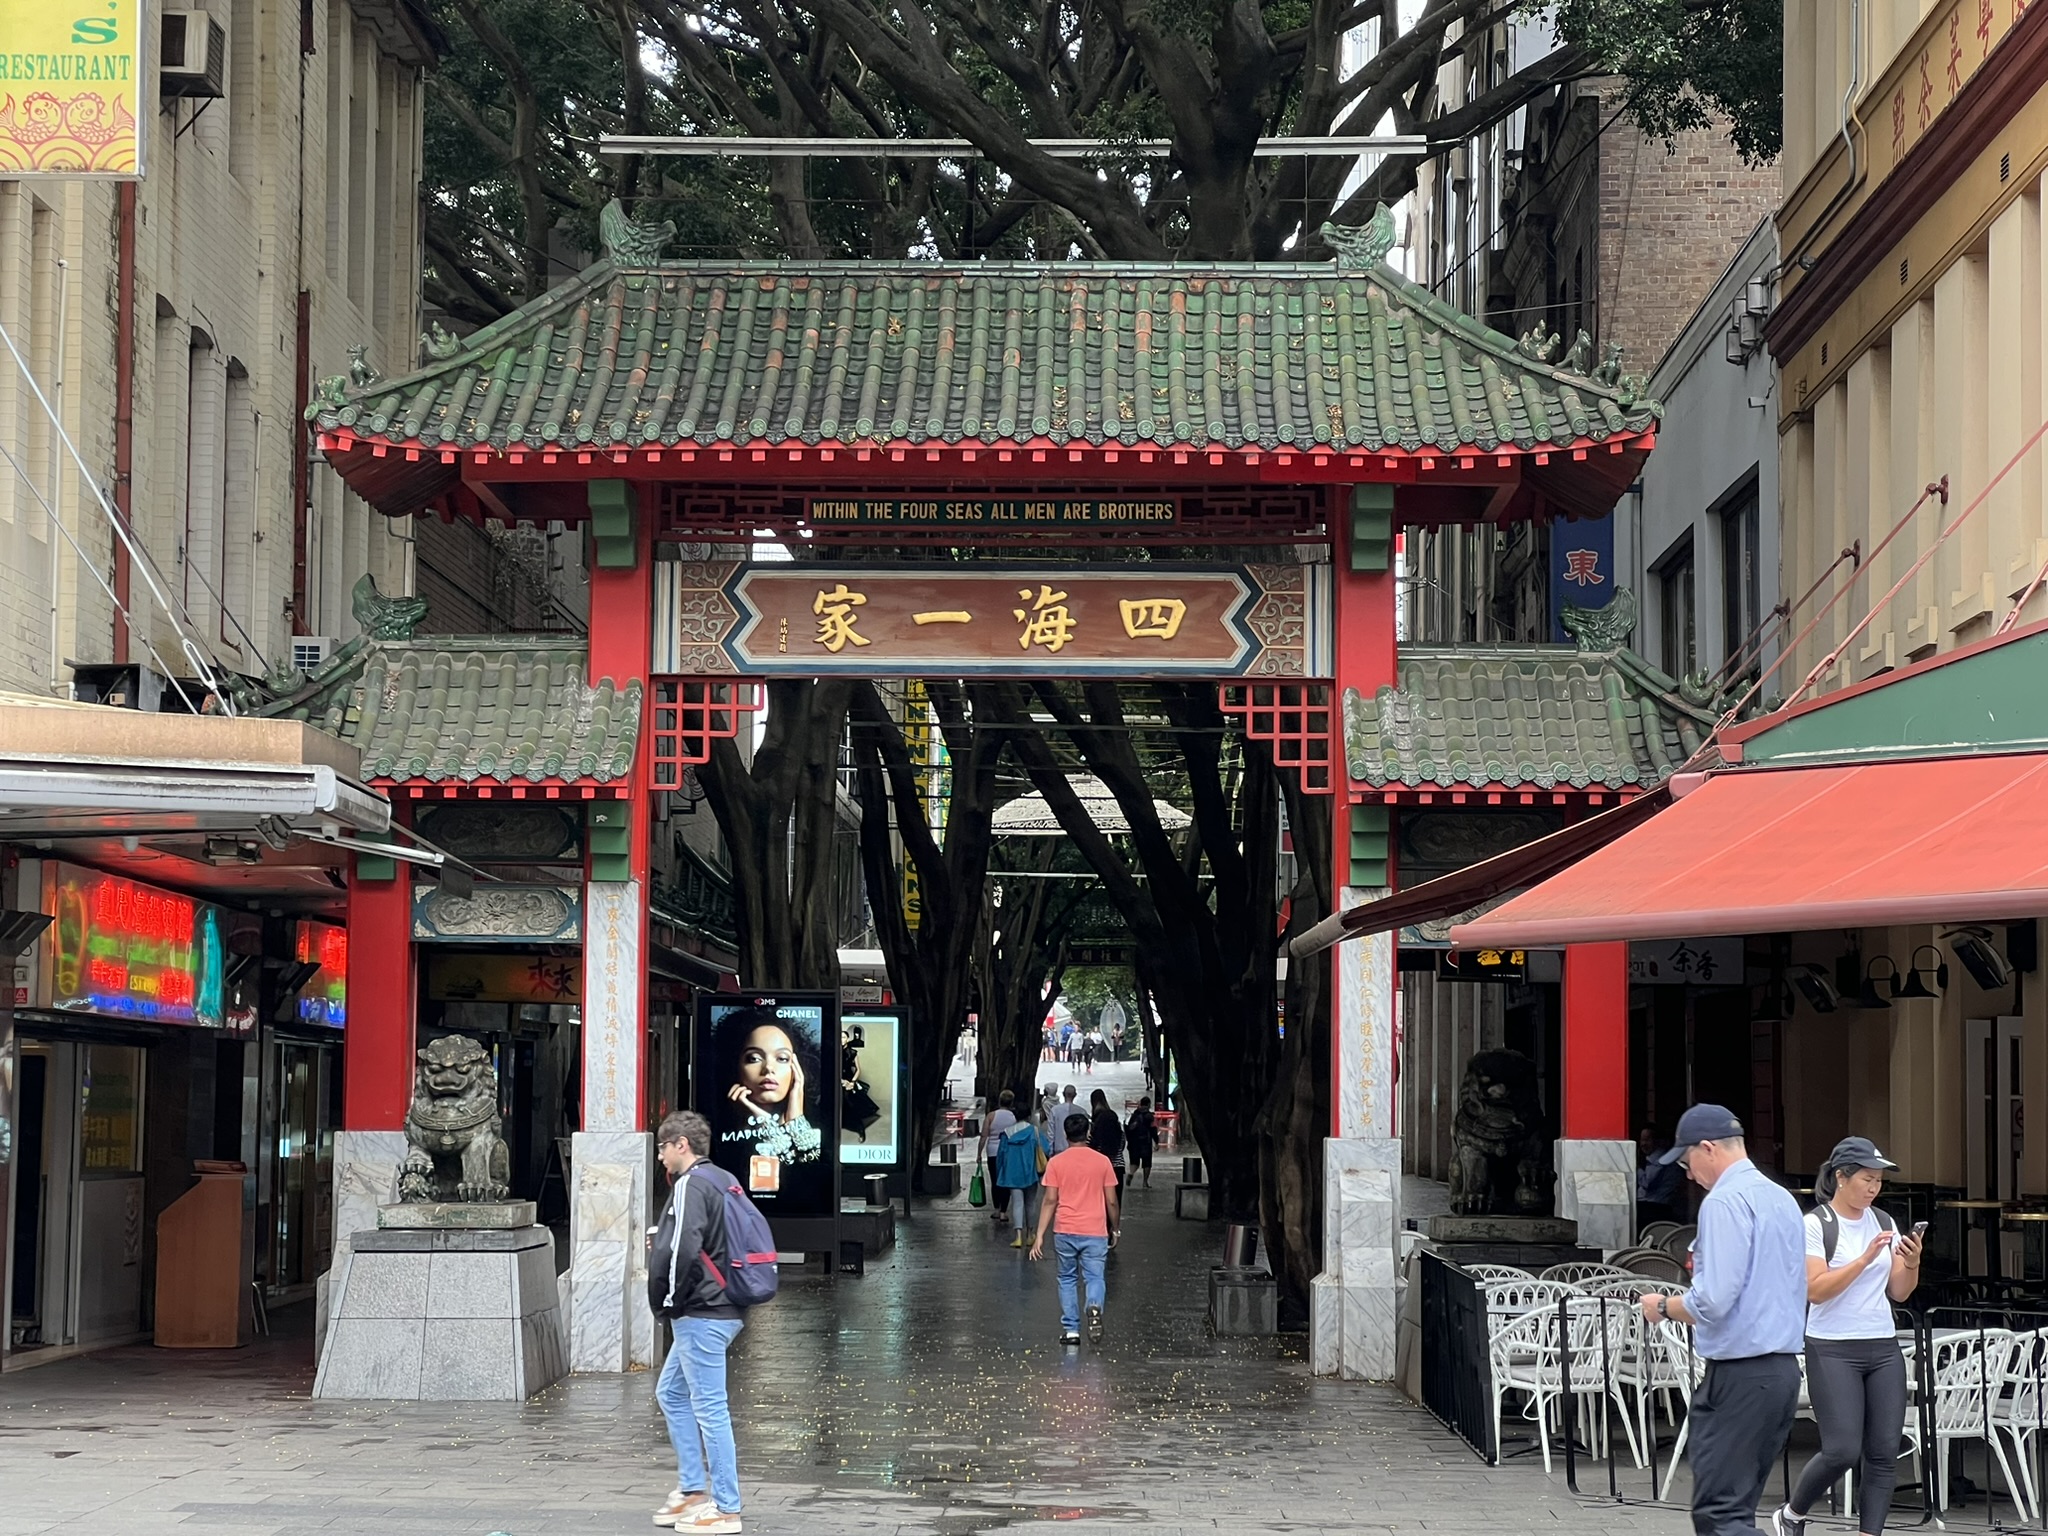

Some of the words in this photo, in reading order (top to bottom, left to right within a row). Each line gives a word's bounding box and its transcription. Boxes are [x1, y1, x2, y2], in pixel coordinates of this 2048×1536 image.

[0, 54, 131, 81] RESTAURANT
[813, 502, 858, 519] WITHIN
[865, 502, 893, 519] THE
[900, 502, 937, 519] FOUR
[946, 502, 983, 519] SEAS
[991, 502, 1018, 519] ALL
[1025, 502, 1055, 519] MEN
[1063, 502, 1091, 519] ARE
[1099, 502, 1173, 519] BROTHERS
[1563, 548, 1605, 587] 東
[812, 584, 1188, 653] 四海一家
[775, 1009, 818, 1019] CHANEL
[858, 1149, 892, 1160] DIOR
